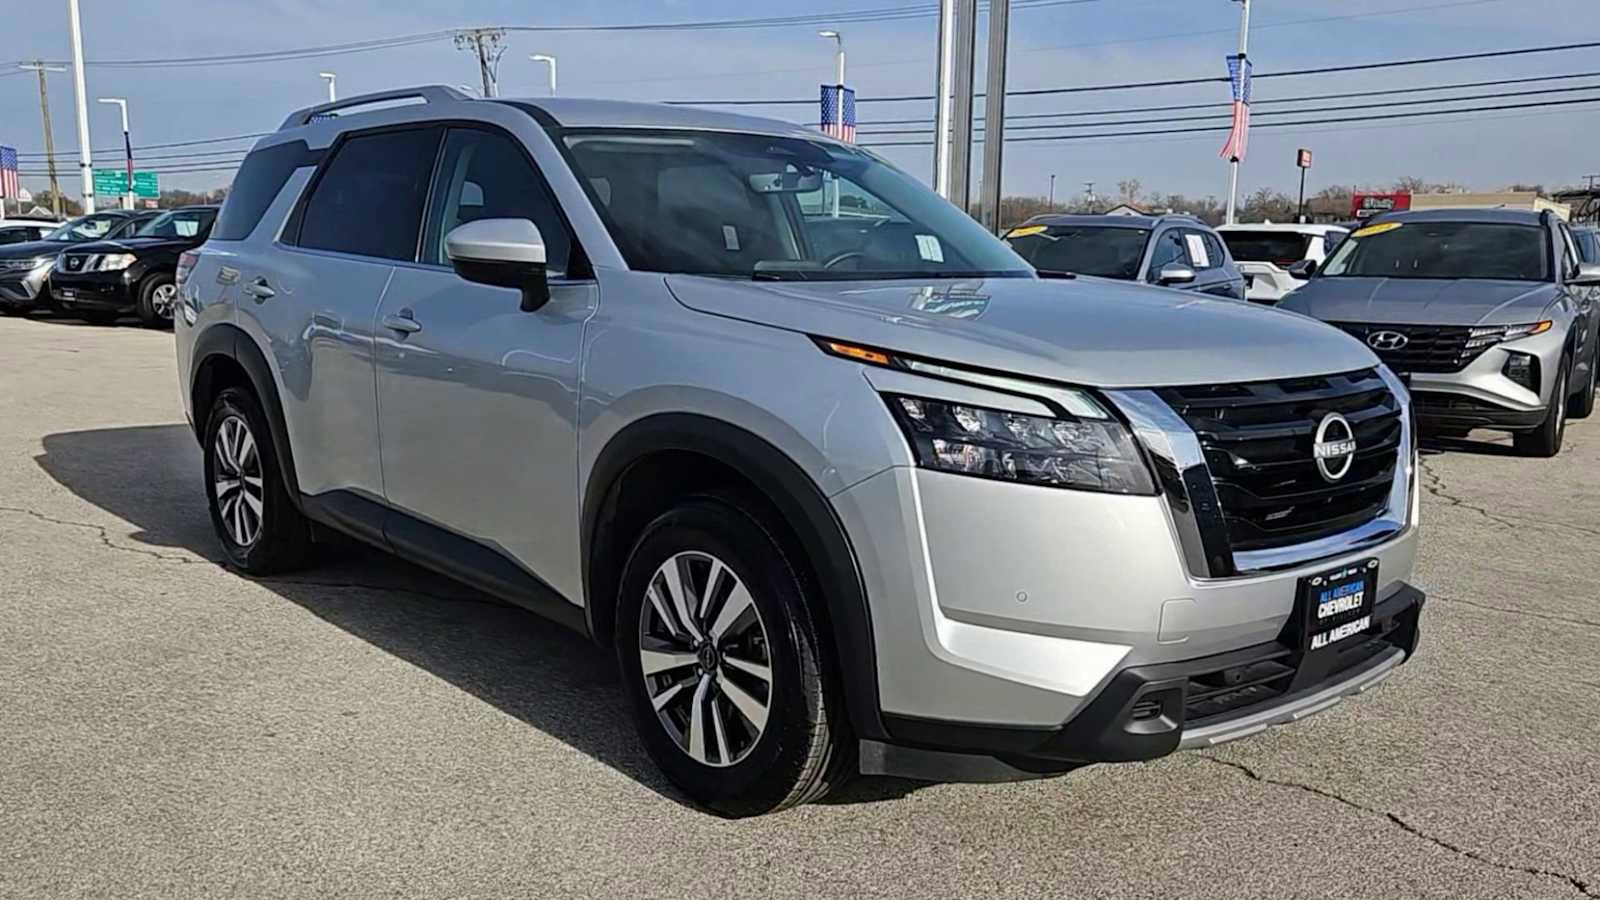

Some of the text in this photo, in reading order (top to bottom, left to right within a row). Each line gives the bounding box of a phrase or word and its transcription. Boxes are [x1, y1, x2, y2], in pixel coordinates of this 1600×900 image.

[1314, 442, 1356, 457] NISSAN
[1320, 581, 1364, 602] ALL AMERICAN
[1318, 591, 1364, 618] CHEVROLET
[1311, 632, 1328, 650] ALL
[1328, 616, 1370, 643] AMERICAN
